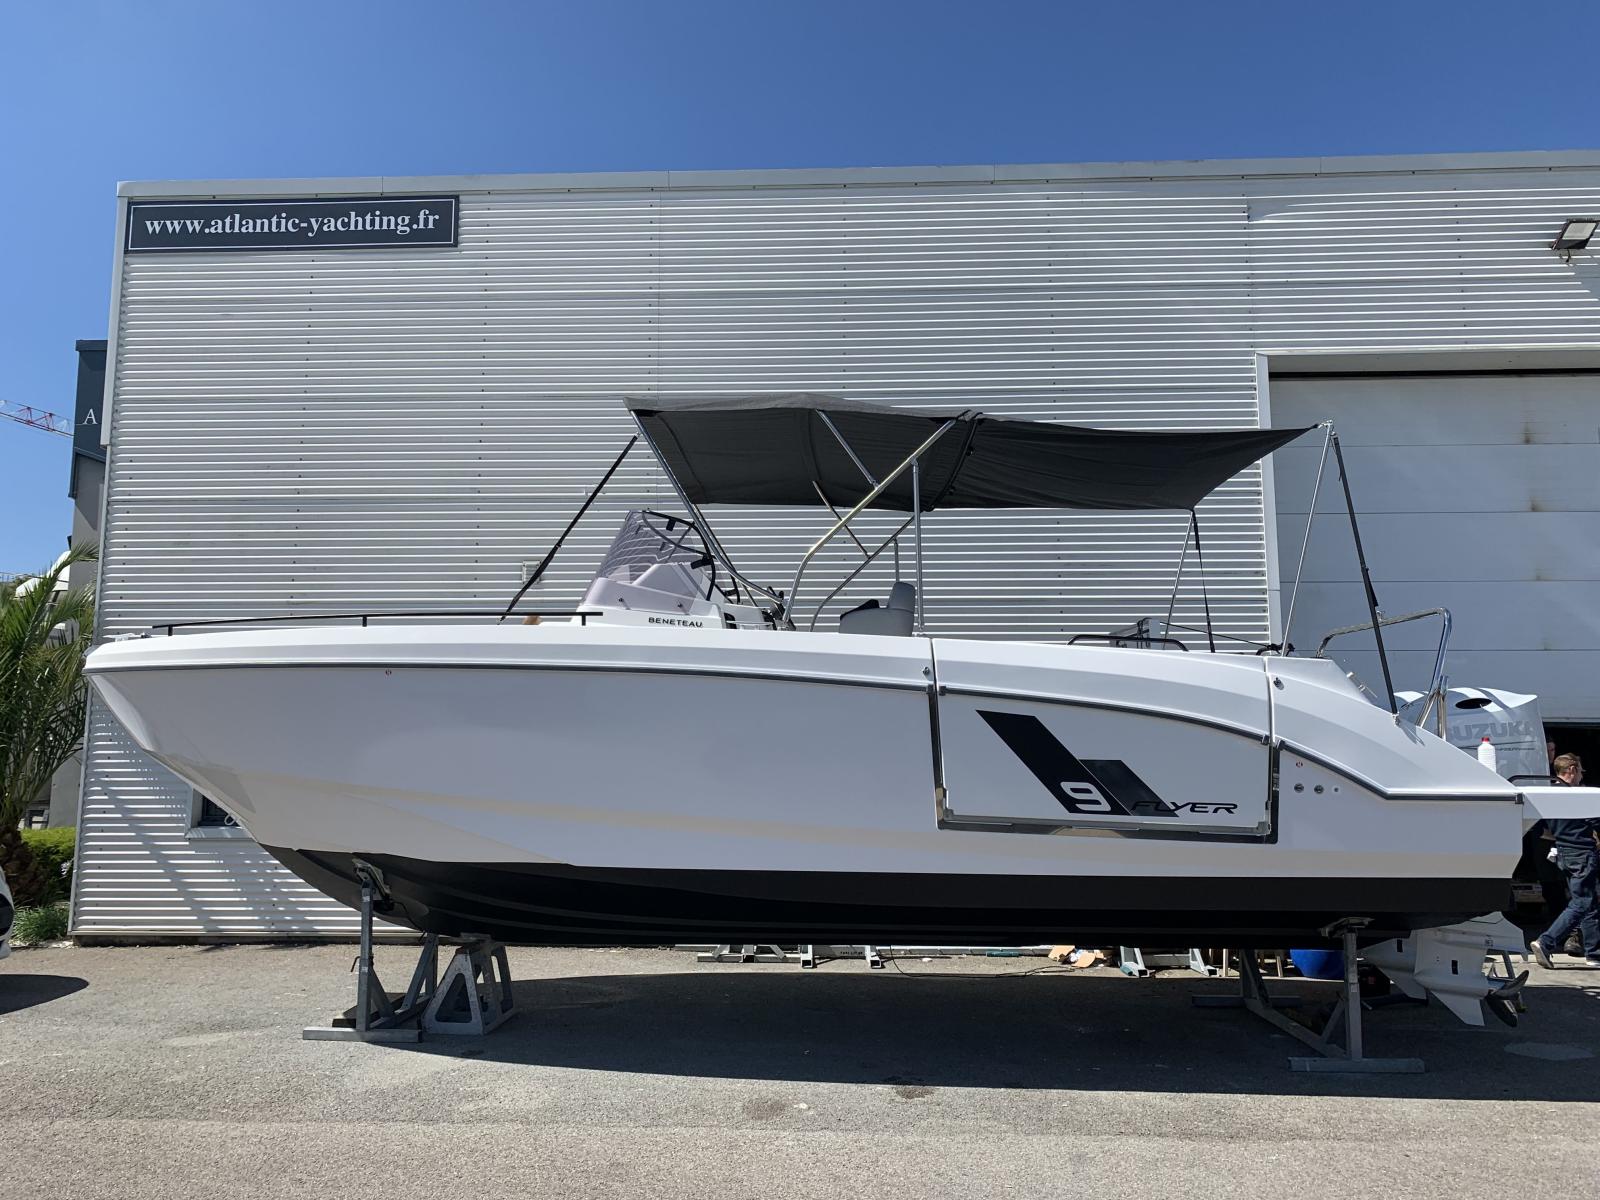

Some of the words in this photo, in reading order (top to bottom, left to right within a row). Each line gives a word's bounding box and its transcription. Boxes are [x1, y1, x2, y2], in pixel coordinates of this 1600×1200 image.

[145, 209, 439, 237] www.atlantic-yachting.fr
[648, 617, 703, 628] BENETEAU
[1130, 801, 1238, 815] FLYER
